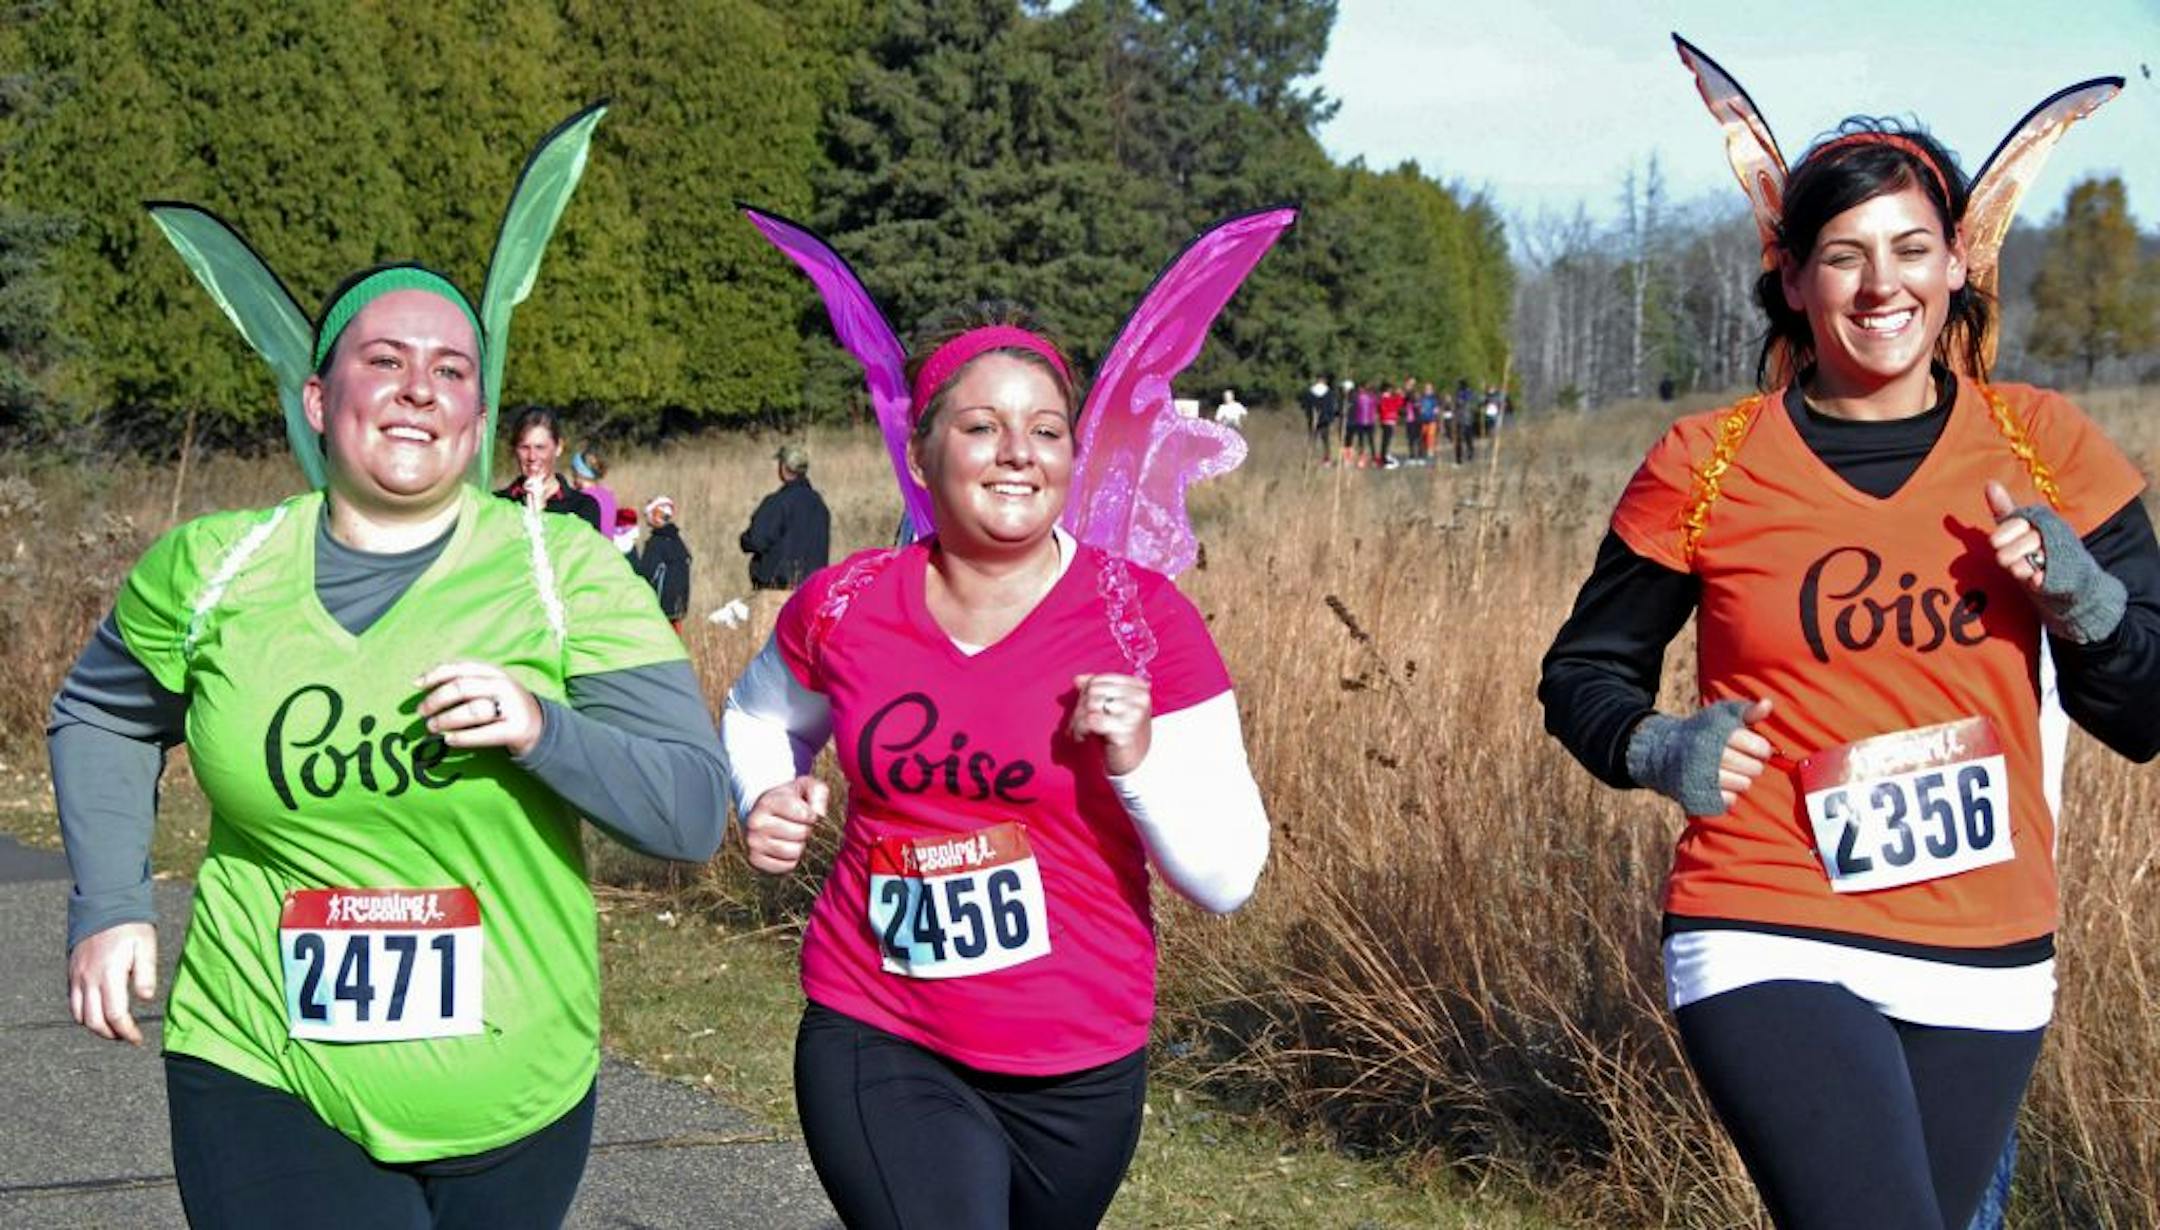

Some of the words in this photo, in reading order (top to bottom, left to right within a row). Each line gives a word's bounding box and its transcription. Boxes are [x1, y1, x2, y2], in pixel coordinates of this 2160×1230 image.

[1800, 547, 1992, 664] Poise
[264, 684, 463, 810] Poise
[858, 692, 1039, 804] Poise
[1824, 765, 1995, 875] 2356
[881, 869, 1030, 961] 2456
[294, 933, 455, 1021] 2471
